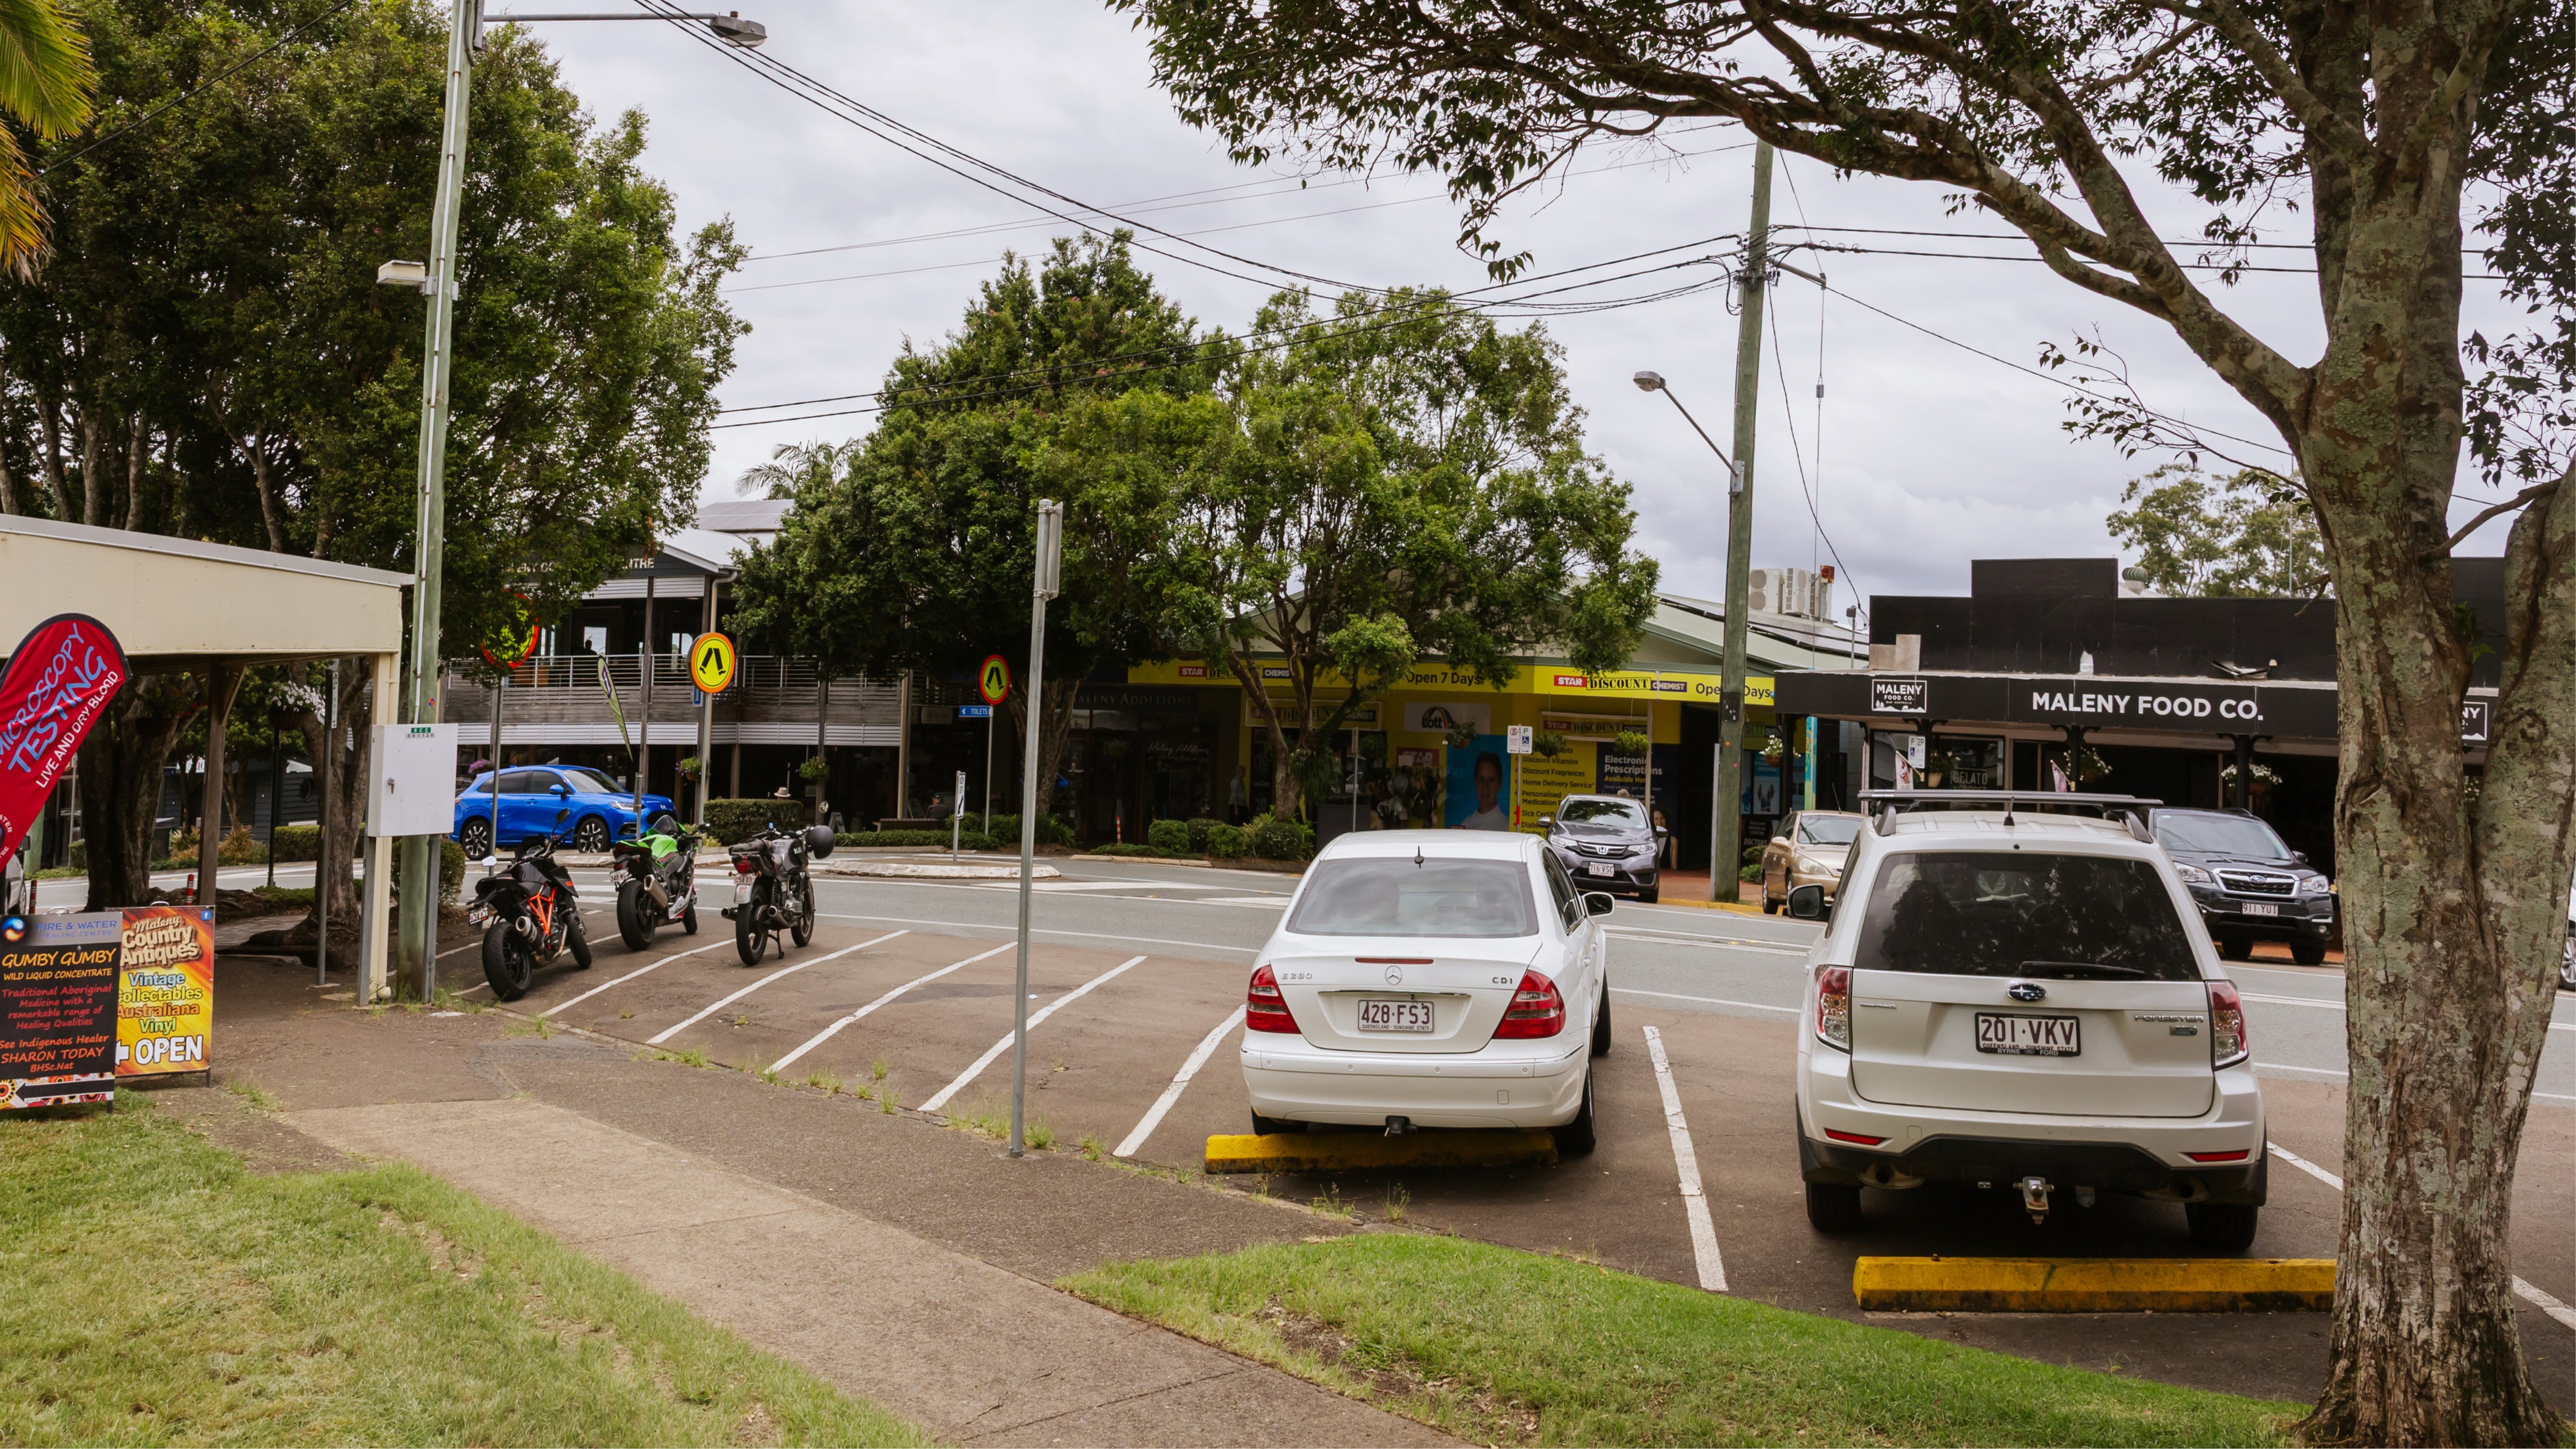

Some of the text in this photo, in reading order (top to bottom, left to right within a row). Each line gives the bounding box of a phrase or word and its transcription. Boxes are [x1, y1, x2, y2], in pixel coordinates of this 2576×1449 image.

[1406, 671, 1481, 686] Open 7 Days
[1558, 676, 1685, 691] STAR DISCOUNT CHEMIST
[0, 623, 84, 764] MICROSCOPY
[1696, 683, 1721, 697] Ope
[1876, 684, 1923, 695] MALENY
[8, 645, 107, 773] TESTING
[2032, 691, 2264, 721] MALENY FOOD CO.
[35, 671, 118, 788] LIVE AND DRY BLOOD
[1546, 721, 1569, 729] STAR
[1573, 722, 1621, 732] DISCOUNT
[1917, 738, 1925, 746] 2P
[1403, 751, 1433, 764] TAR
[1551, 769, 1585, 777] Fragrances
[1953, 770, 1988, 785] GELATO
[1543, 780, 1568, 788] Delivery
[1744, 837, 1768, 846] DOCTORS
[37, 922, 63, 931] FIRE
[77, 920, 117, 929] WATER
[133, 916, 180, 933] Maleny
[122, 925, 193, 949] Country
[2, 948, 117, 968] GUMBY GUMBY
[120, 942, 198, 966] Antiques
[3, 968, 112, 981] WILD LIQUID CONCENTRATE
[128, 971, 186, 989] Vintage
[1, 983, 112, 997] Traditional Aboriginal
[19, 999, 59, 1007] Medicine
[63, 996, 84, 1006] with
[8, 1005, 104, 1019] remarkable range of
[117, 1002, 200, 1018] Australiana
[16, 1018, 93, 1030] Healing Qualities
[139, 1017, 177, 1035] Vinyl
[2134, 1014, 2203, 1023] FORESTER
[0, 1033, 110, 1049] See Indigenous Healer
[1, 1046, 105, 1064] SHARON TODAY
[135, 1034, 204, 1065] OPEN
